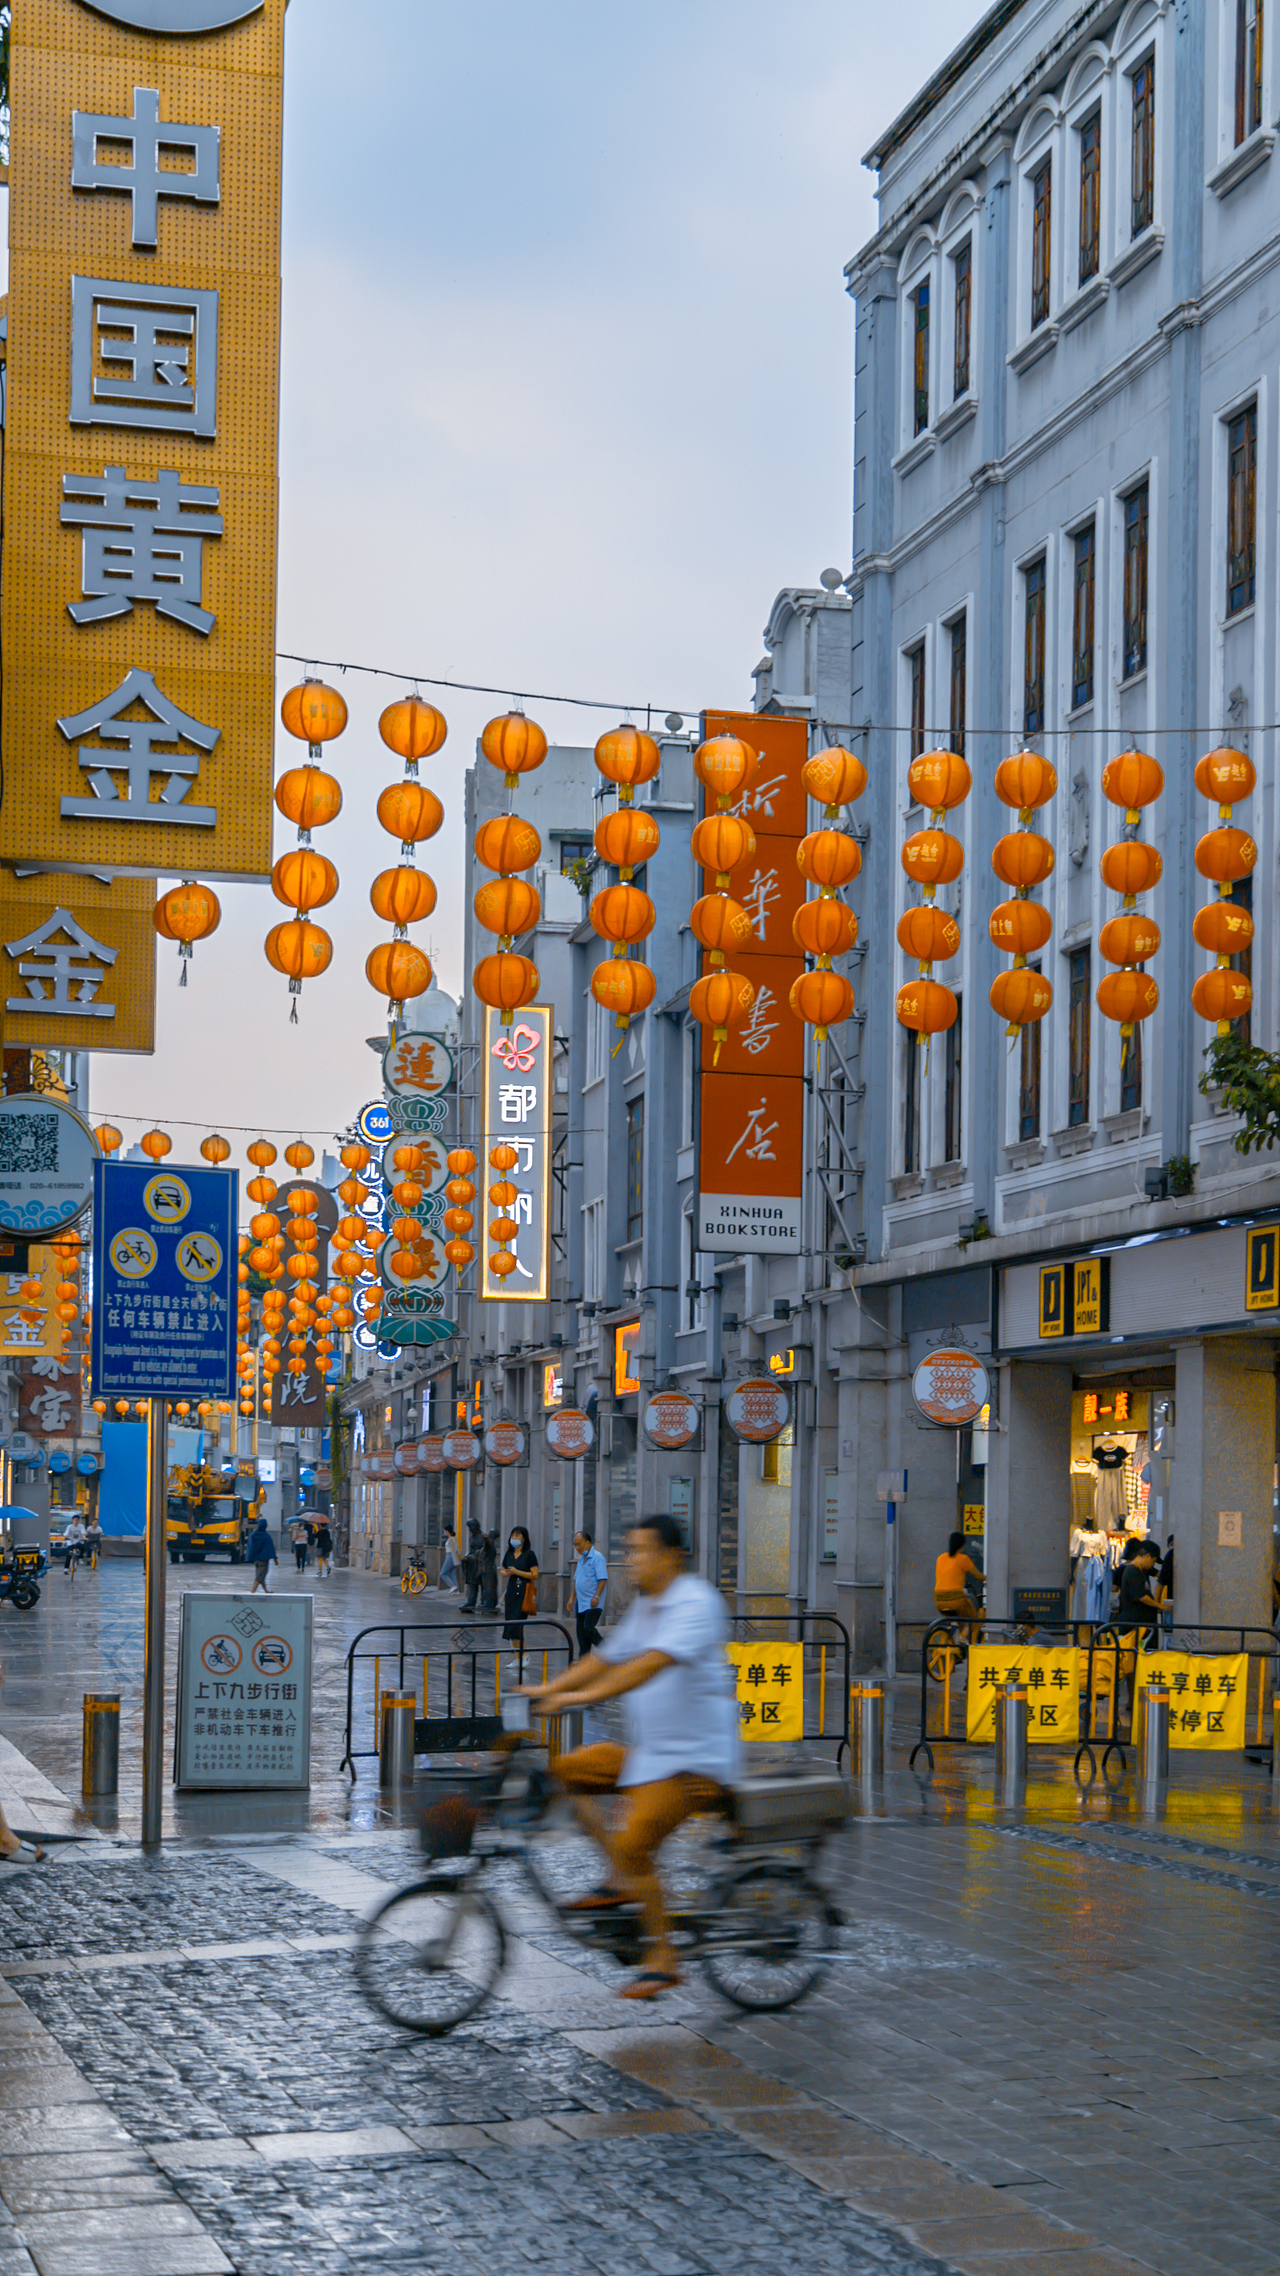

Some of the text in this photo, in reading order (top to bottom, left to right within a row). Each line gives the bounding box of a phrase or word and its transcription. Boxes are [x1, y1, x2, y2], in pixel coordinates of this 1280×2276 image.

[57, 86, 224, 828] 中国黄金
[720, 1205, 783, 1219] XINHUA
[705, 1222, 798, 1238] BOOKSTORE
[1076, 1269, 1092, 1306] JPT
[107, 1308, 224, 1332] 任何车辆禁止进入
[1076, 1309, 1098, 1326] HOME
[978, 1666, 1070, 1691] 共享单车
[1146, 1670, 1238, 1697] 共享单车
[194, 1682, 298, 1701] 上下九步行街
[194, 1707, 297, 1721] 严禁社会车辆进入
[193, 1723, 297, 1737] 非机动车下车推行
